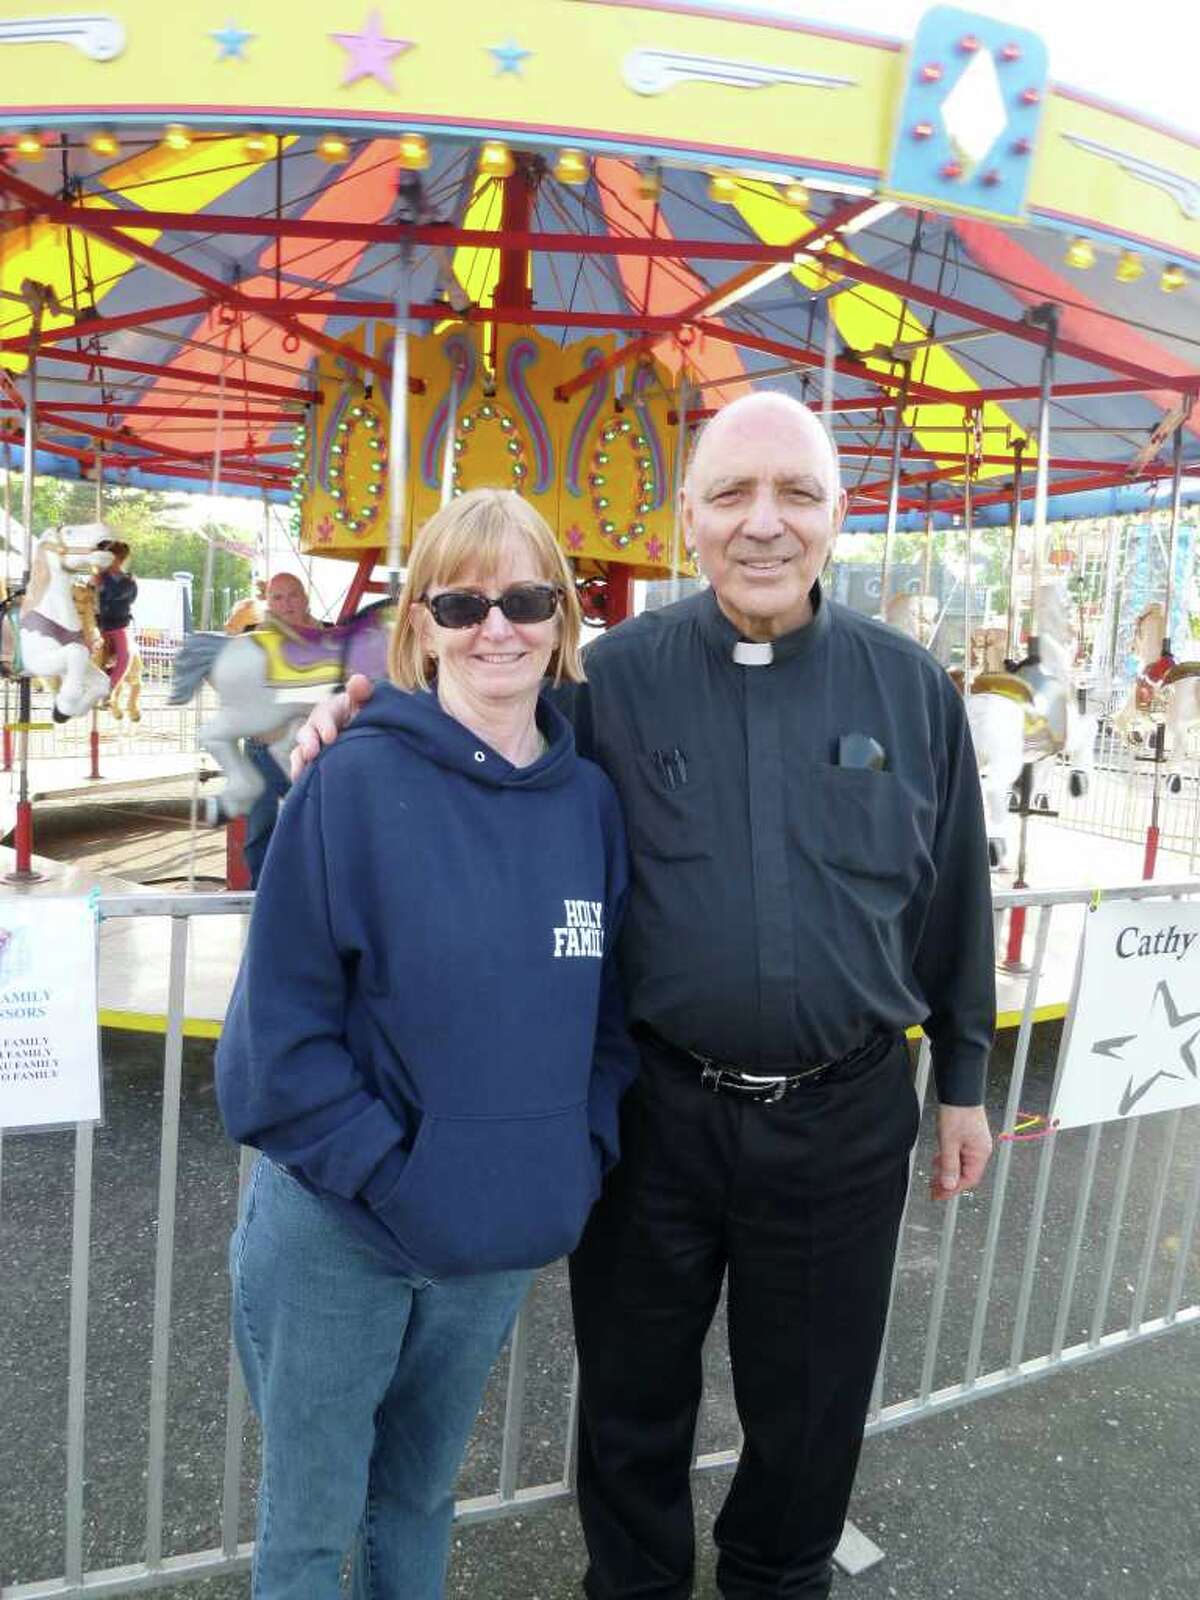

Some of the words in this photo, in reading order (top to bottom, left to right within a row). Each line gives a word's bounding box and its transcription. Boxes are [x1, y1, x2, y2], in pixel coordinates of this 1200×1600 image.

[564, 899, 602, 929] HOLY
[553, 927, 604, 958] FAMIL
[1115, 925, 1198, 960] Cathy
[0, 988, 52, 1004] AMILY
[0, 1006, 47, 1020] SORS
